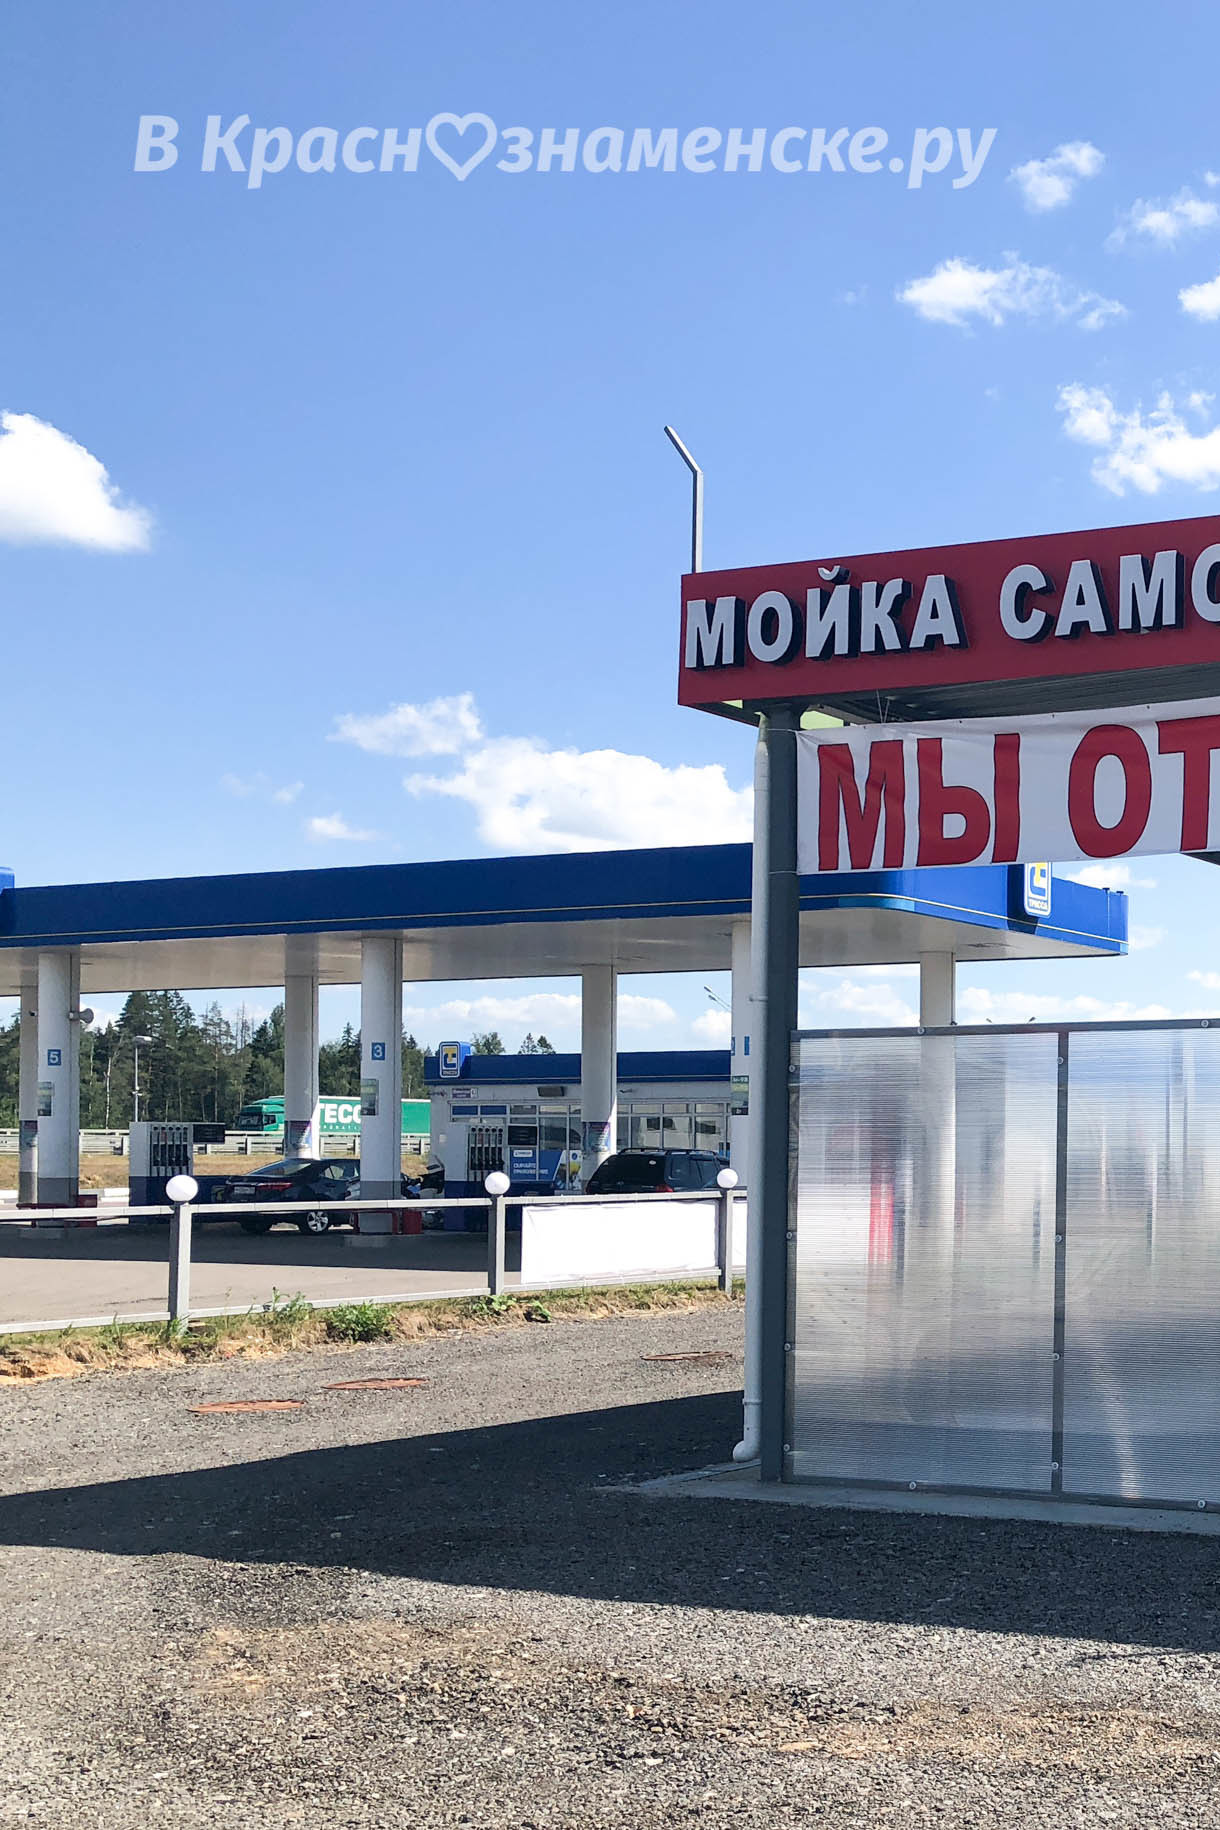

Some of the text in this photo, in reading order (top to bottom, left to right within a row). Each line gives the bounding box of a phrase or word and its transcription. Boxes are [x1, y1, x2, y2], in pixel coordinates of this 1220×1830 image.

[684, 565, 965, 670] МОЙКА
[817, 731, 1021, 872] МЫ
[49, 1051, 59, 1064] 5
[374, 1044, 383, 1058] 3
